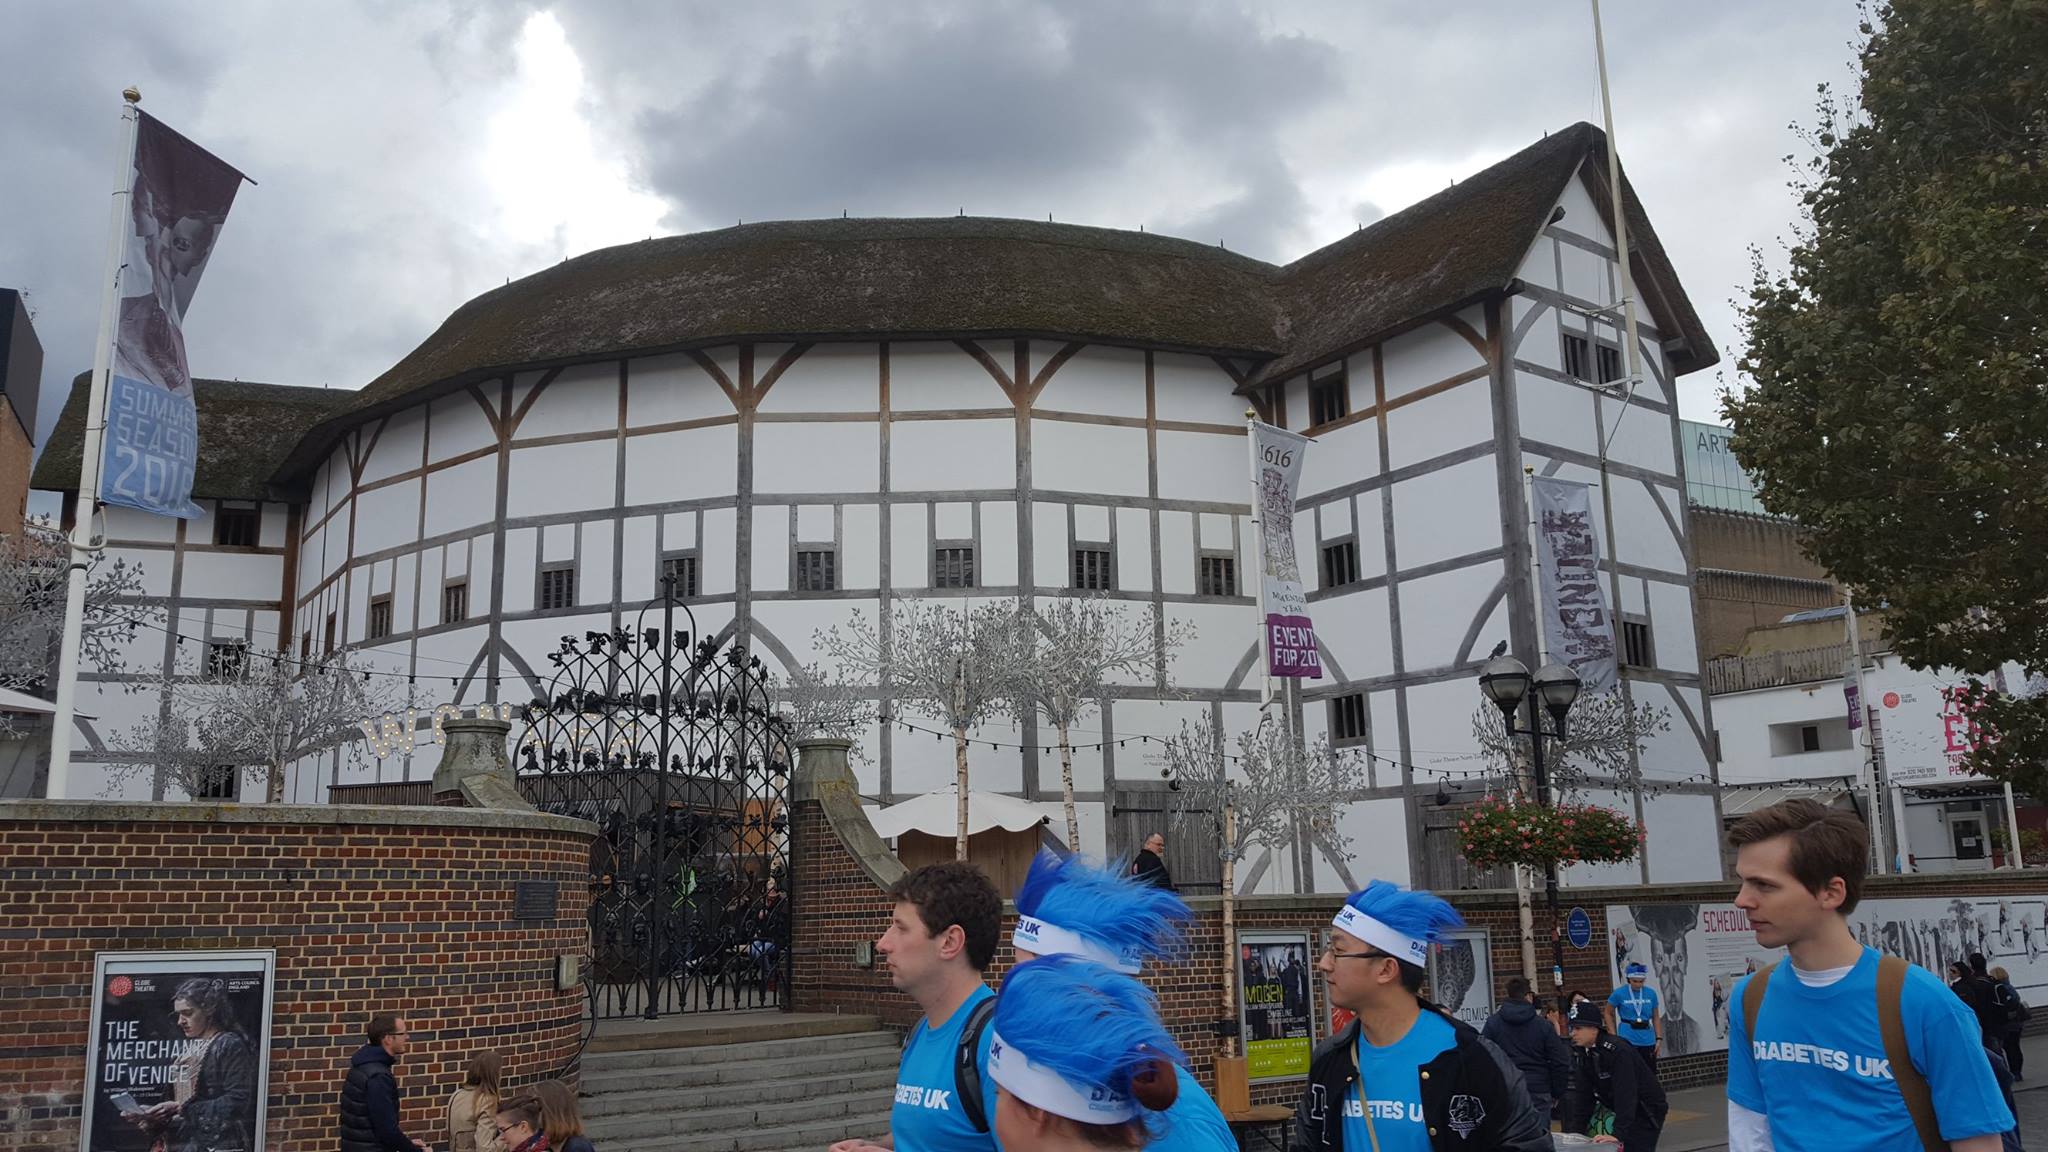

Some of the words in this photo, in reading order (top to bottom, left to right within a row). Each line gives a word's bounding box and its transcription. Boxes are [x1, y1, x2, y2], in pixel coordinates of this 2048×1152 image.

[120, 384, 193, 432] SUMME
[1697, 432, 1731, 454] ART
[1260, 445, 1293, 468] 1616
[1273, 625, 1316, 647] EVENT
[1275, 648, 1297, 666] FOR
[1343, 910, 1356, 921] UK
[1704, 911, 1752, 933] SCHEDUL
[1025, 921, 1041, 936] UK
[105, 1020, 140, 1040] THE
[106, 1038, 208, 1061] MERCHANT
[104, 1062, 128, 1083] OF
[128, 1064, 191, 1086] VENICE
[1855, 1055, 1895, 1080] UK
[924, 1088, 951, 1111] UK
[1408, 1103, 1424, 1123] U
